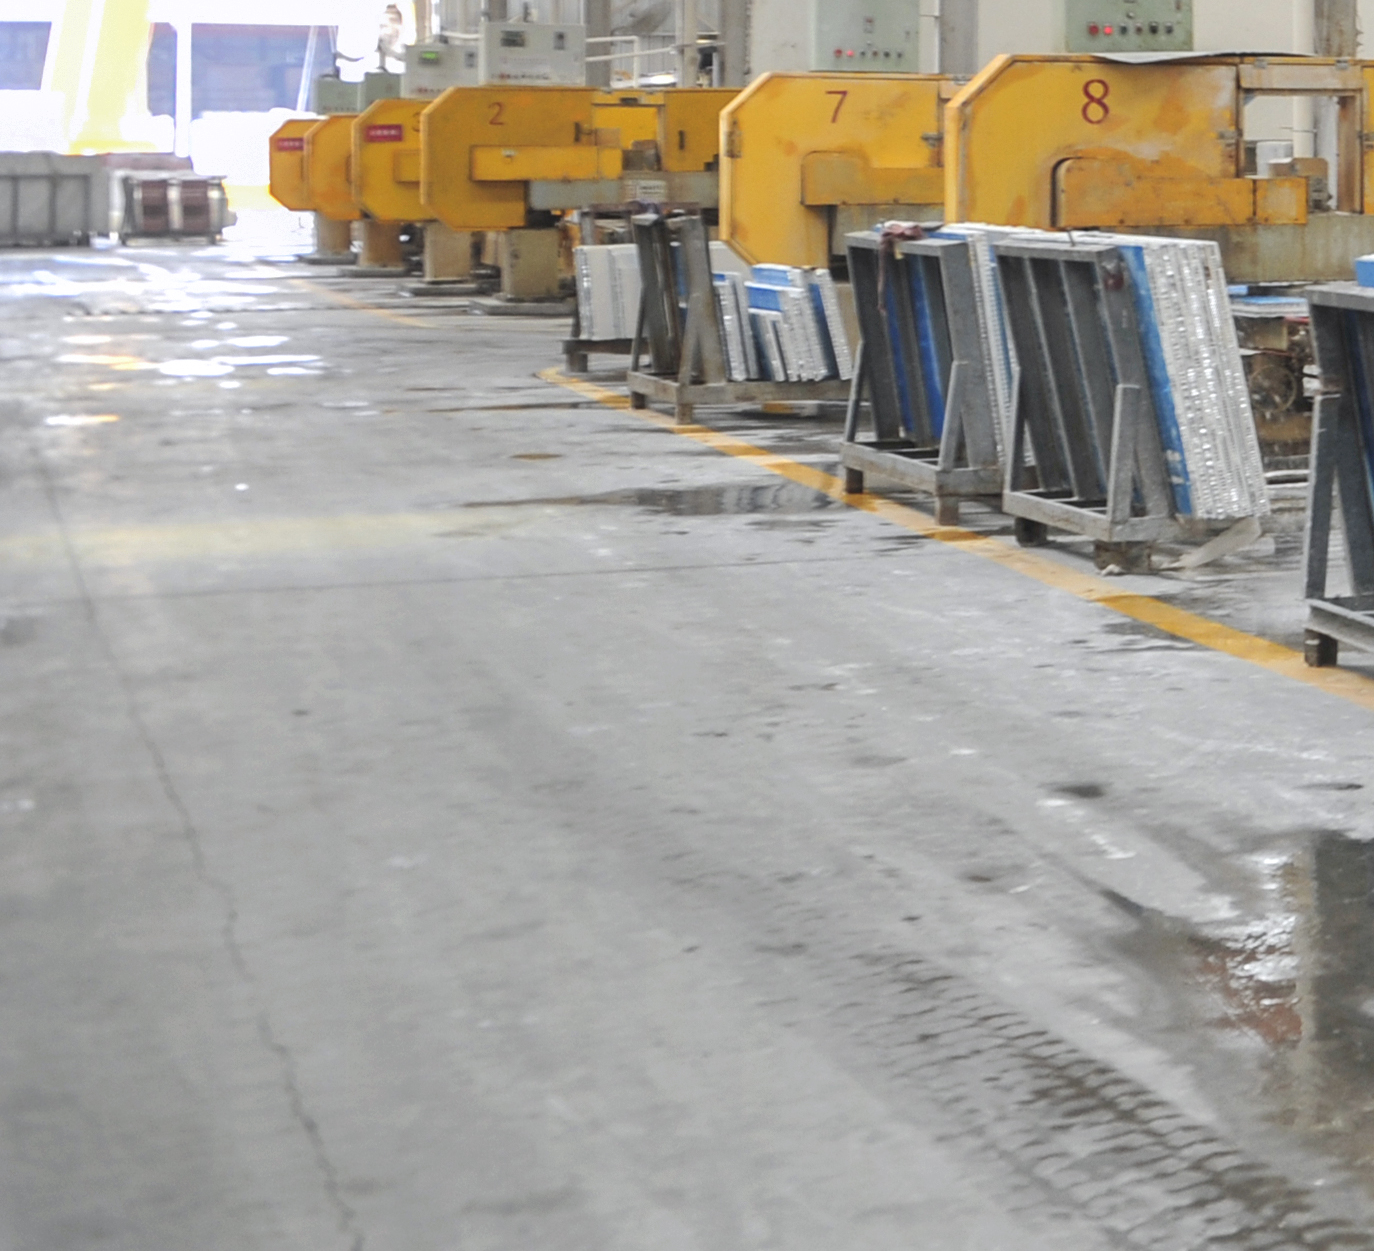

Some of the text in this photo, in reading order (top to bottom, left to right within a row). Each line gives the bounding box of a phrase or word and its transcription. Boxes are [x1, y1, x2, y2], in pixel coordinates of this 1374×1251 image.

[488, 101, 505, 126] 2
[825, 90, 848, 123] 7
[1082, 79, 1110, 124] 8
